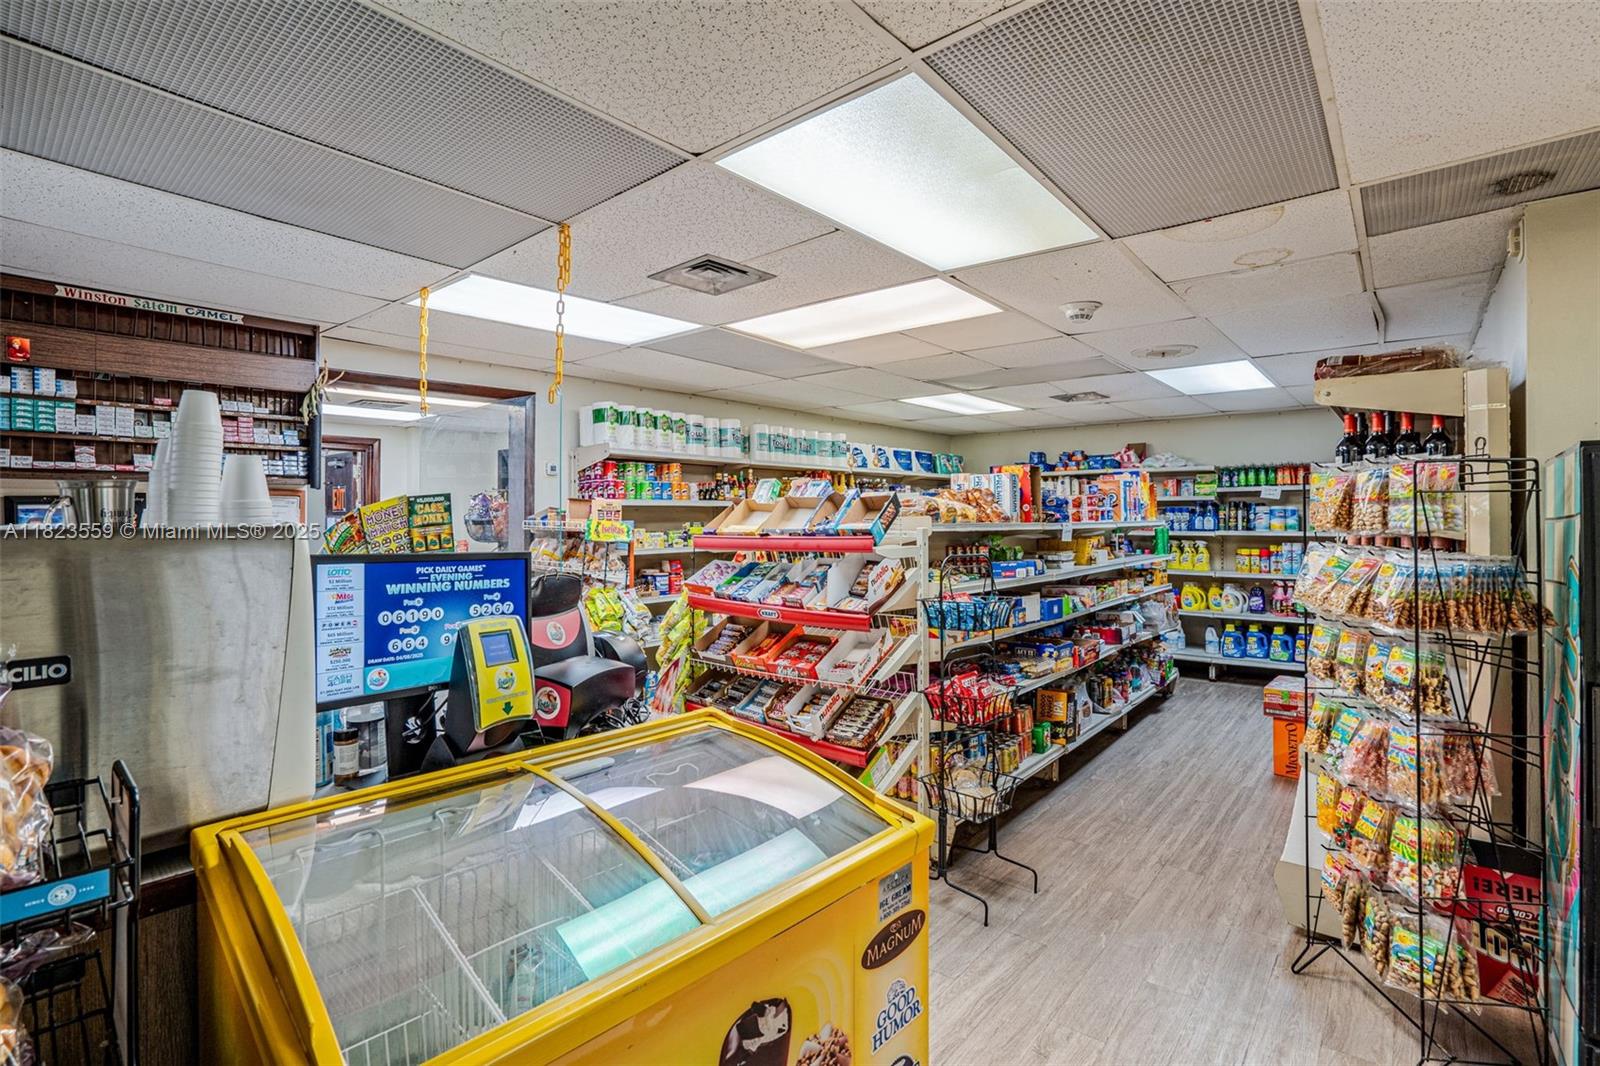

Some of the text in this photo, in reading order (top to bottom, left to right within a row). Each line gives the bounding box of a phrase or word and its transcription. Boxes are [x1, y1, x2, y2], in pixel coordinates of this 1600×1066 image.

[64, 287, 127, 306] Winston
[184, 306, 238, 322] CAMEL
[365, 503, 406, 525] MONEY
[416, 566, 434, 574] PICK
[435, 565, 455, 574] DAILY
[430, 572, 473, 582] EVENING
[386, 578, 510, 595] WINNING NUMBERS
[818, 693, 841, 721] nutella
[866, 912, 922, 967] MAGNUM
[877, 986, 916, 1031] GOOD
[871, 999, 922, 1053] HUMOR
